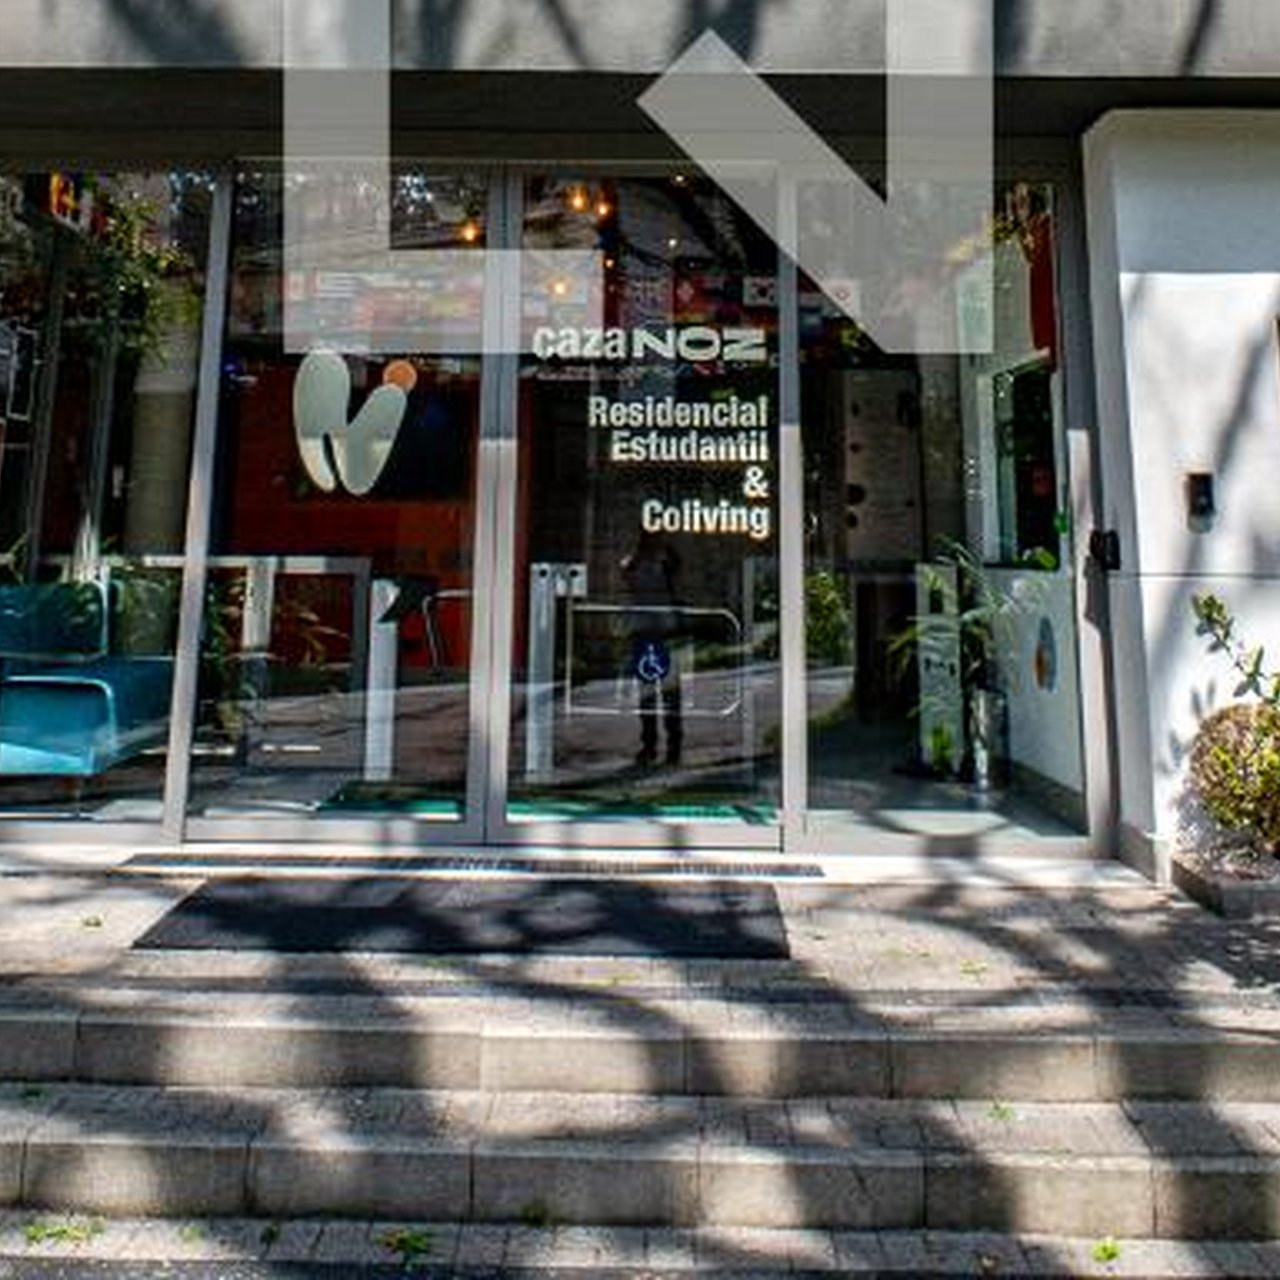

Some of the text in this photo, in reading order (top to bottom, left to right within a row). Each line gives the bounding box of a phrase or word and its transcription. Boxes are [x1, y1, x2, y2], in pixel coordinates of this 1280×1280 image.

[588, 396, 768, 426] Residencial
[611, 430, 768, 461] Estudantil
[743, 466, 768, 497] &
[642, 499, 768, 538] Coliving
